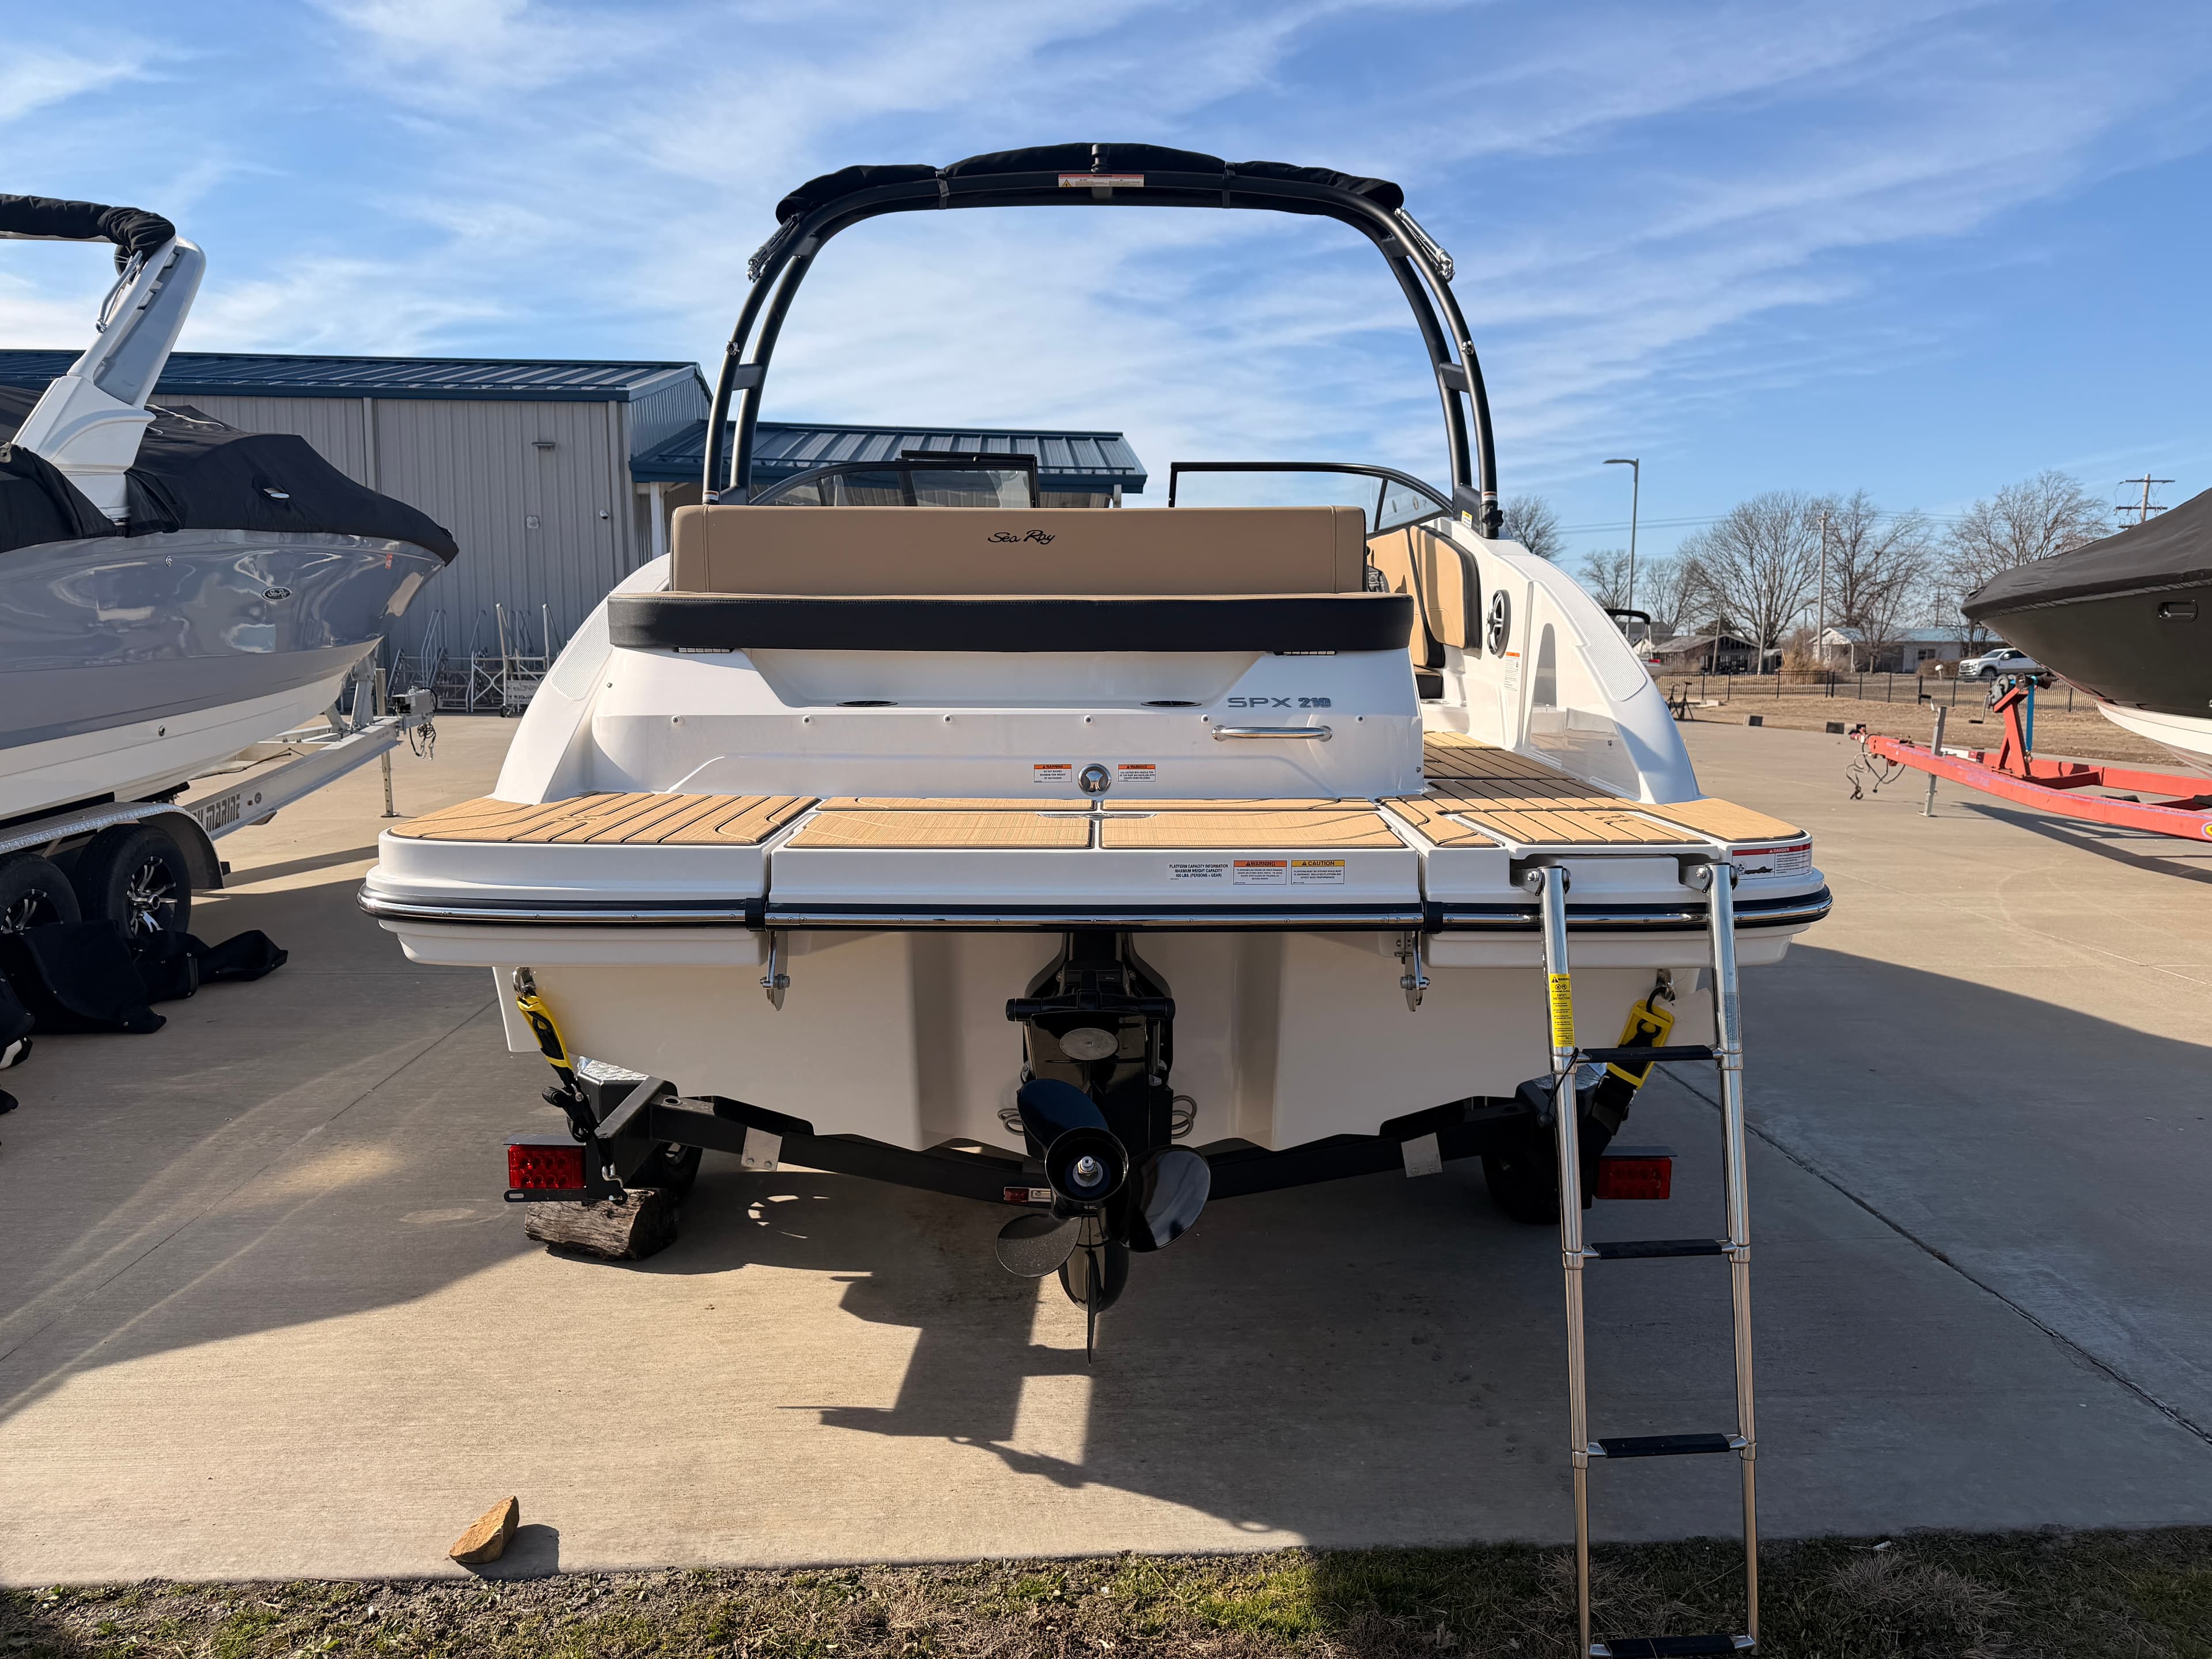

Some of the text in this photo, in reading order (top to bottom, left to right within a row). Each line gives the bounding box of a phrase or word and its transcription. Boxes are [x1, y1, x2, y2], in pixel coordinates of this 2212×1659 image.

[987, 529, 1056, 545] Sea Ray
[1227, 697, 1331, 708] SPX 210
[206, 793, 240, 832] MARINE
